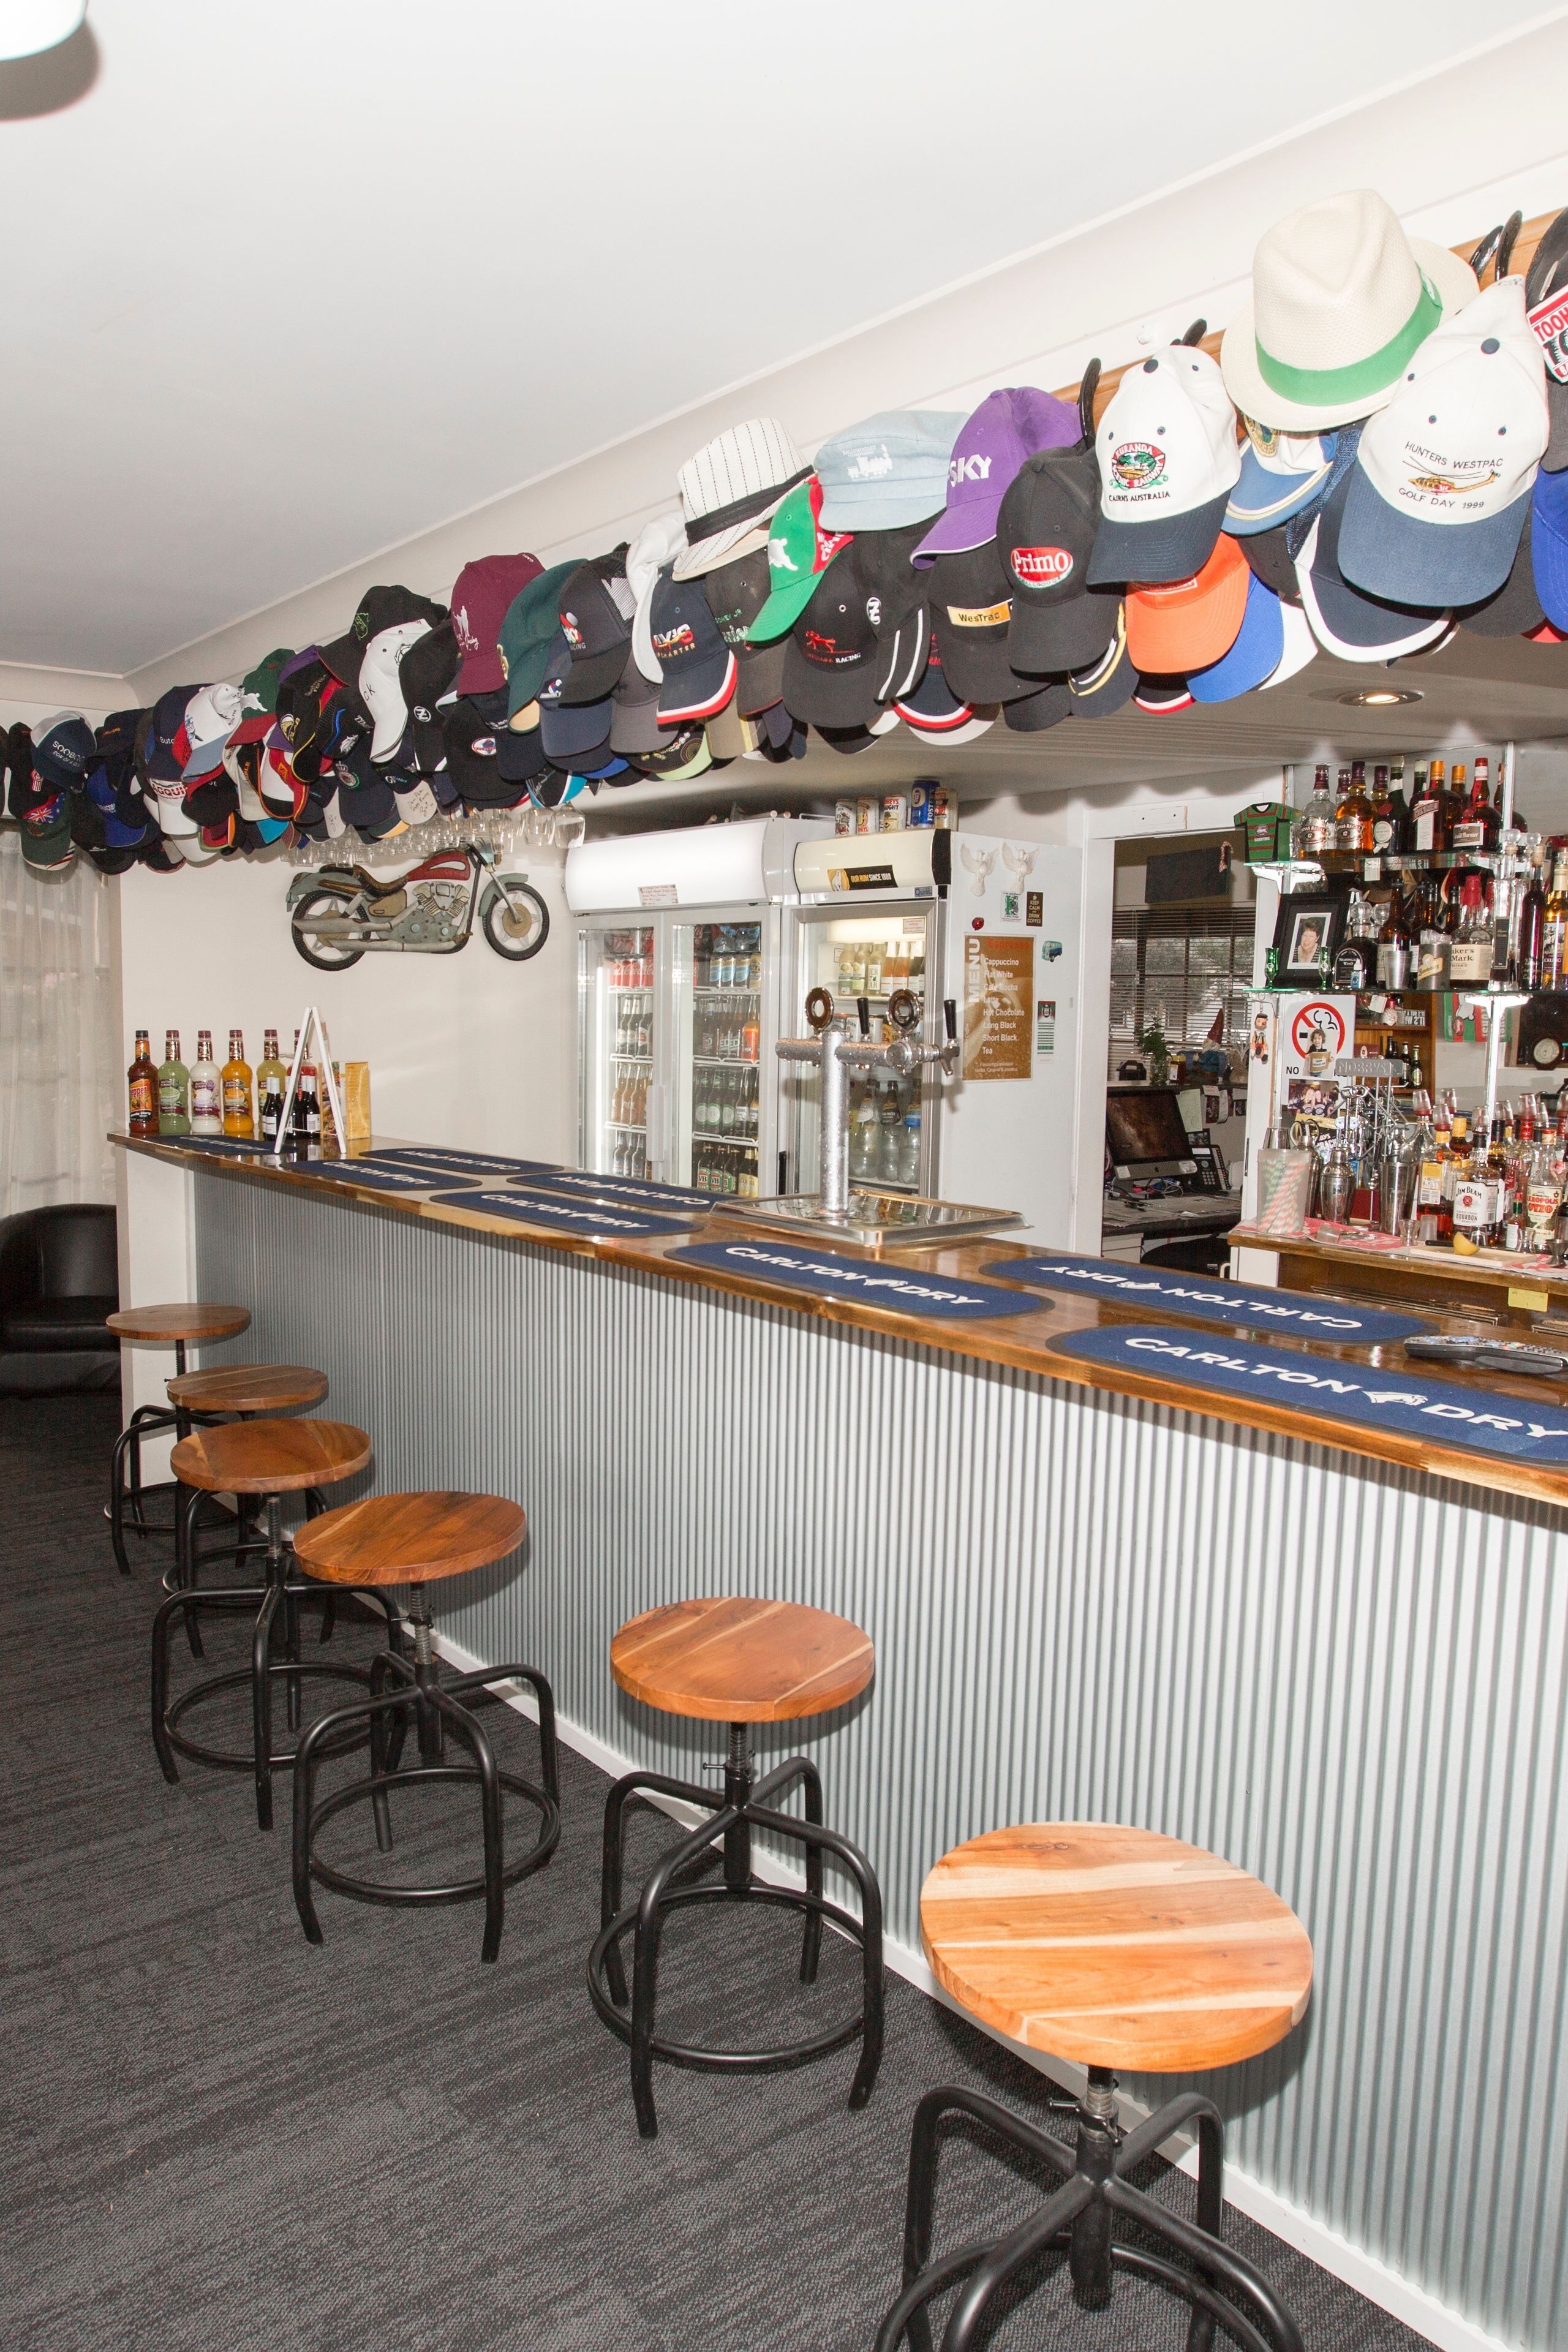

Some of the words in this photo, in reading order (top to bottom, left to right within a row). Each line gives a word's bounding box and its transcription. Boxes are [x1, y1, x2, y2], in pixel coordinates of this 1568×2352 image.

[1534, 306, 1568, 342] TOOH
[1114, 443, 1153, 458] KURANDA
[1405, 441, 1447, 466] HUNTERS
[1453, 458, 1503, 469] WESTPAC
[949, 454, 992, 488] SKY
[1109, 494, 1129, 502] CAIRNS
[1130, 491, 1171, 502] AUSTRALIA
[1398, 488, 1426, 502] GOLF
[1431, 497, 1455, 508] DAY
[835, 652, 862, 664] RACING
[869, 873, 881, 881] SINCE
[968, 938, 980, 1003] MENU
[984, 957, 1019, 967] Cappuccino
[1457, 1187, 1466, 1196] JIM
[1466, 1186, 1482, 1199] BEAM
[726, 1247, 868, 1281] CARLTON
[893, 1285, 987, 1305] DRY
[1035, 1265, 1128, 1284] DRY
[1161, 1287, 1363, 1329] CARLTON
[1125, 1338, 1363, 1394] CARLTON
[1420, 1403, 1568, 1438] DRY
